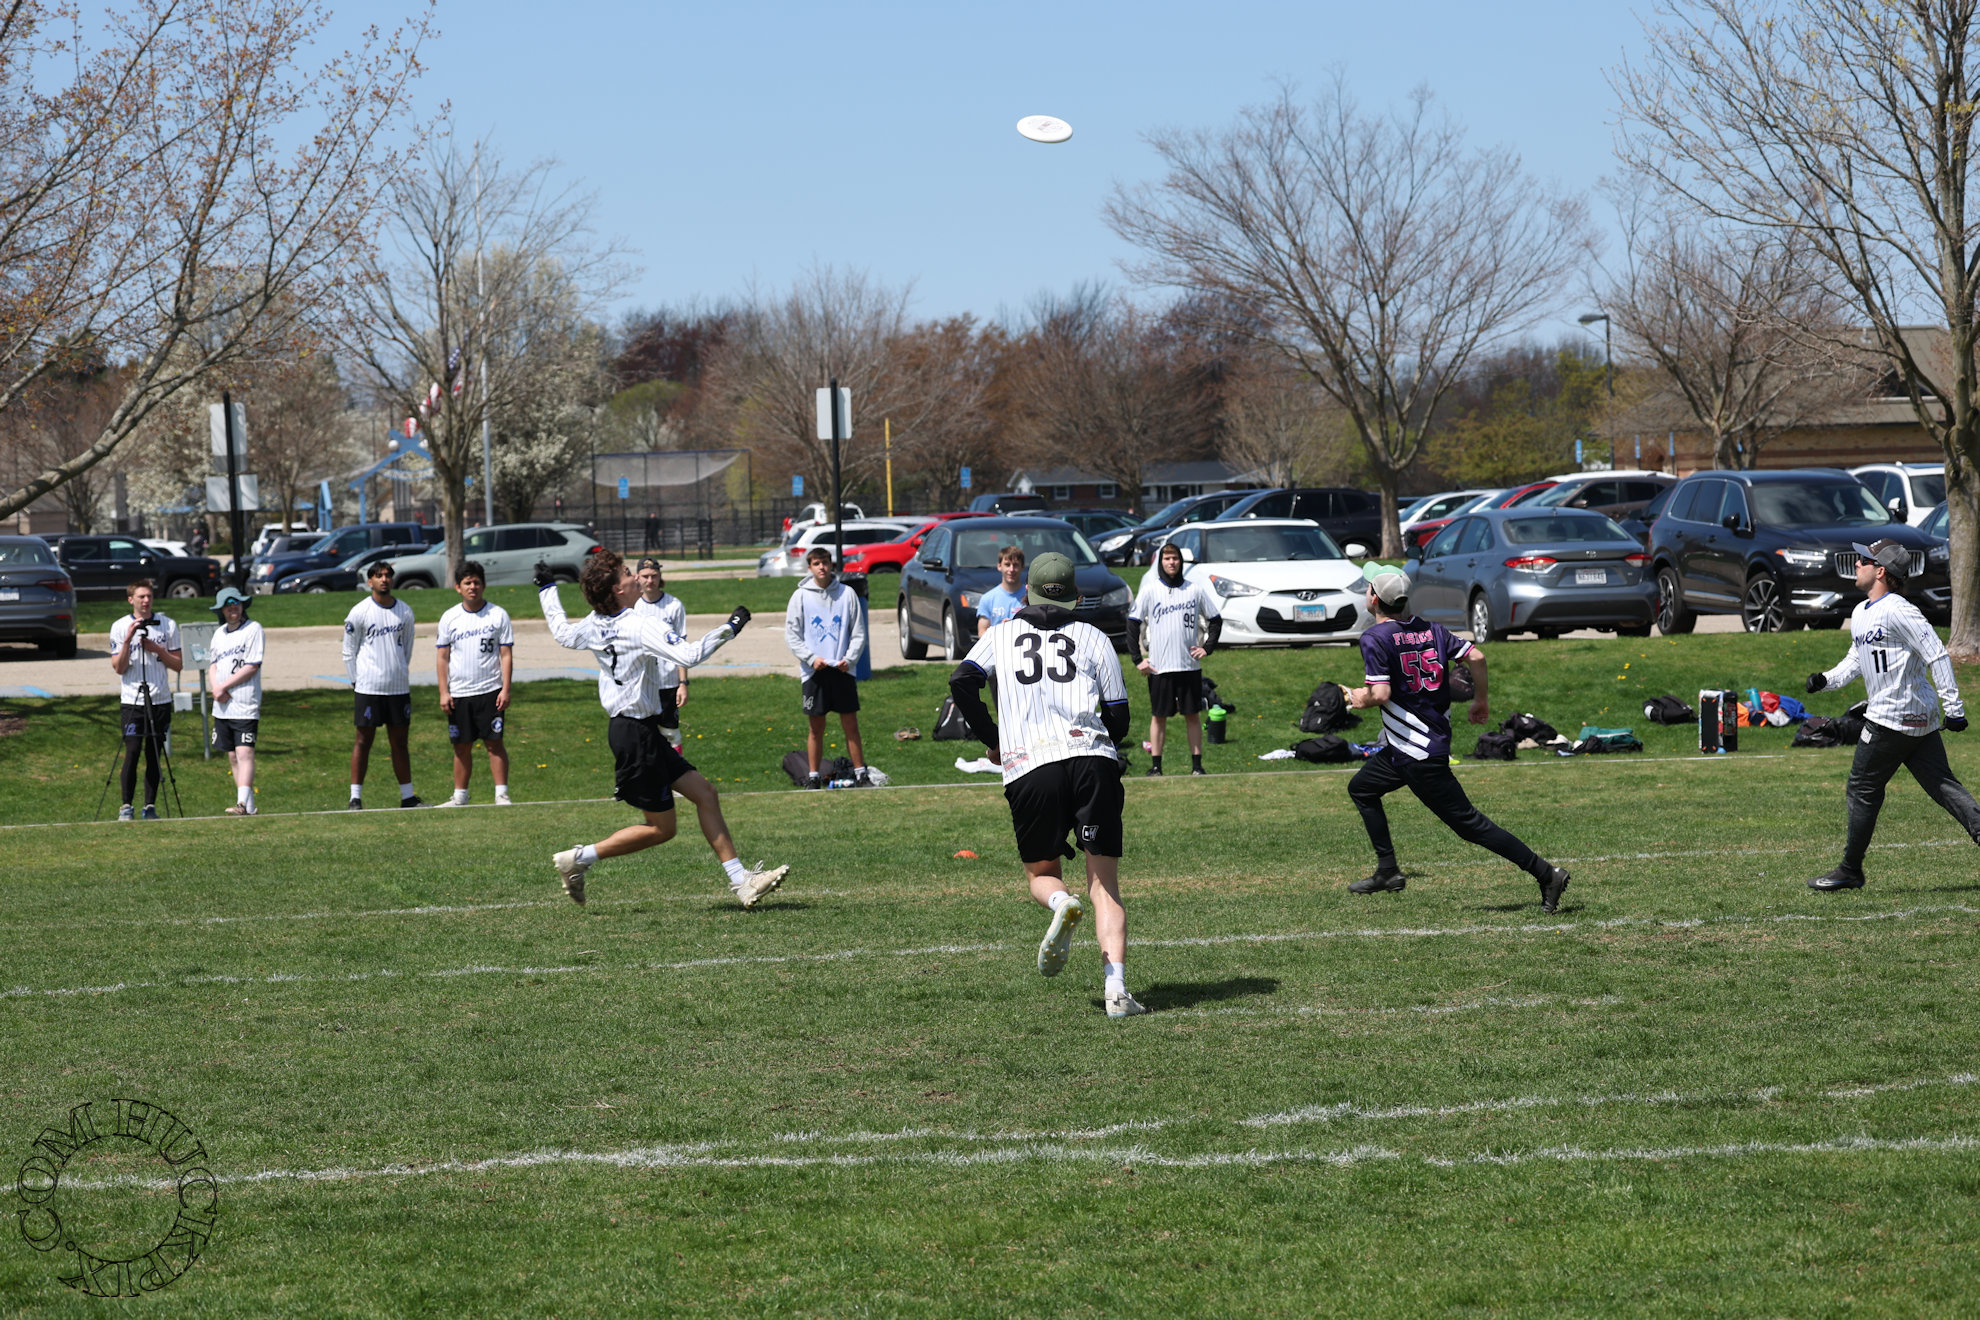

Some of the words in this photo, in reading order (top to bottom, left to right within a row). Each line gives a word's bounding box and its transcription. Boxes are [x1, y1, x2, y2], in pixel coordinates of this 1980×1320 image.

[732, 615, 741, 625] 2
[1152, 598, 1196, 624] Gnomes
[1183, 612, 1196, 629] 99
[480, 637, 495, 653] 55
[1014, 632, 1077, 686] 33
[1399, 647, 1444, 694] 55
[1871, 649, 1888, 674] 11
